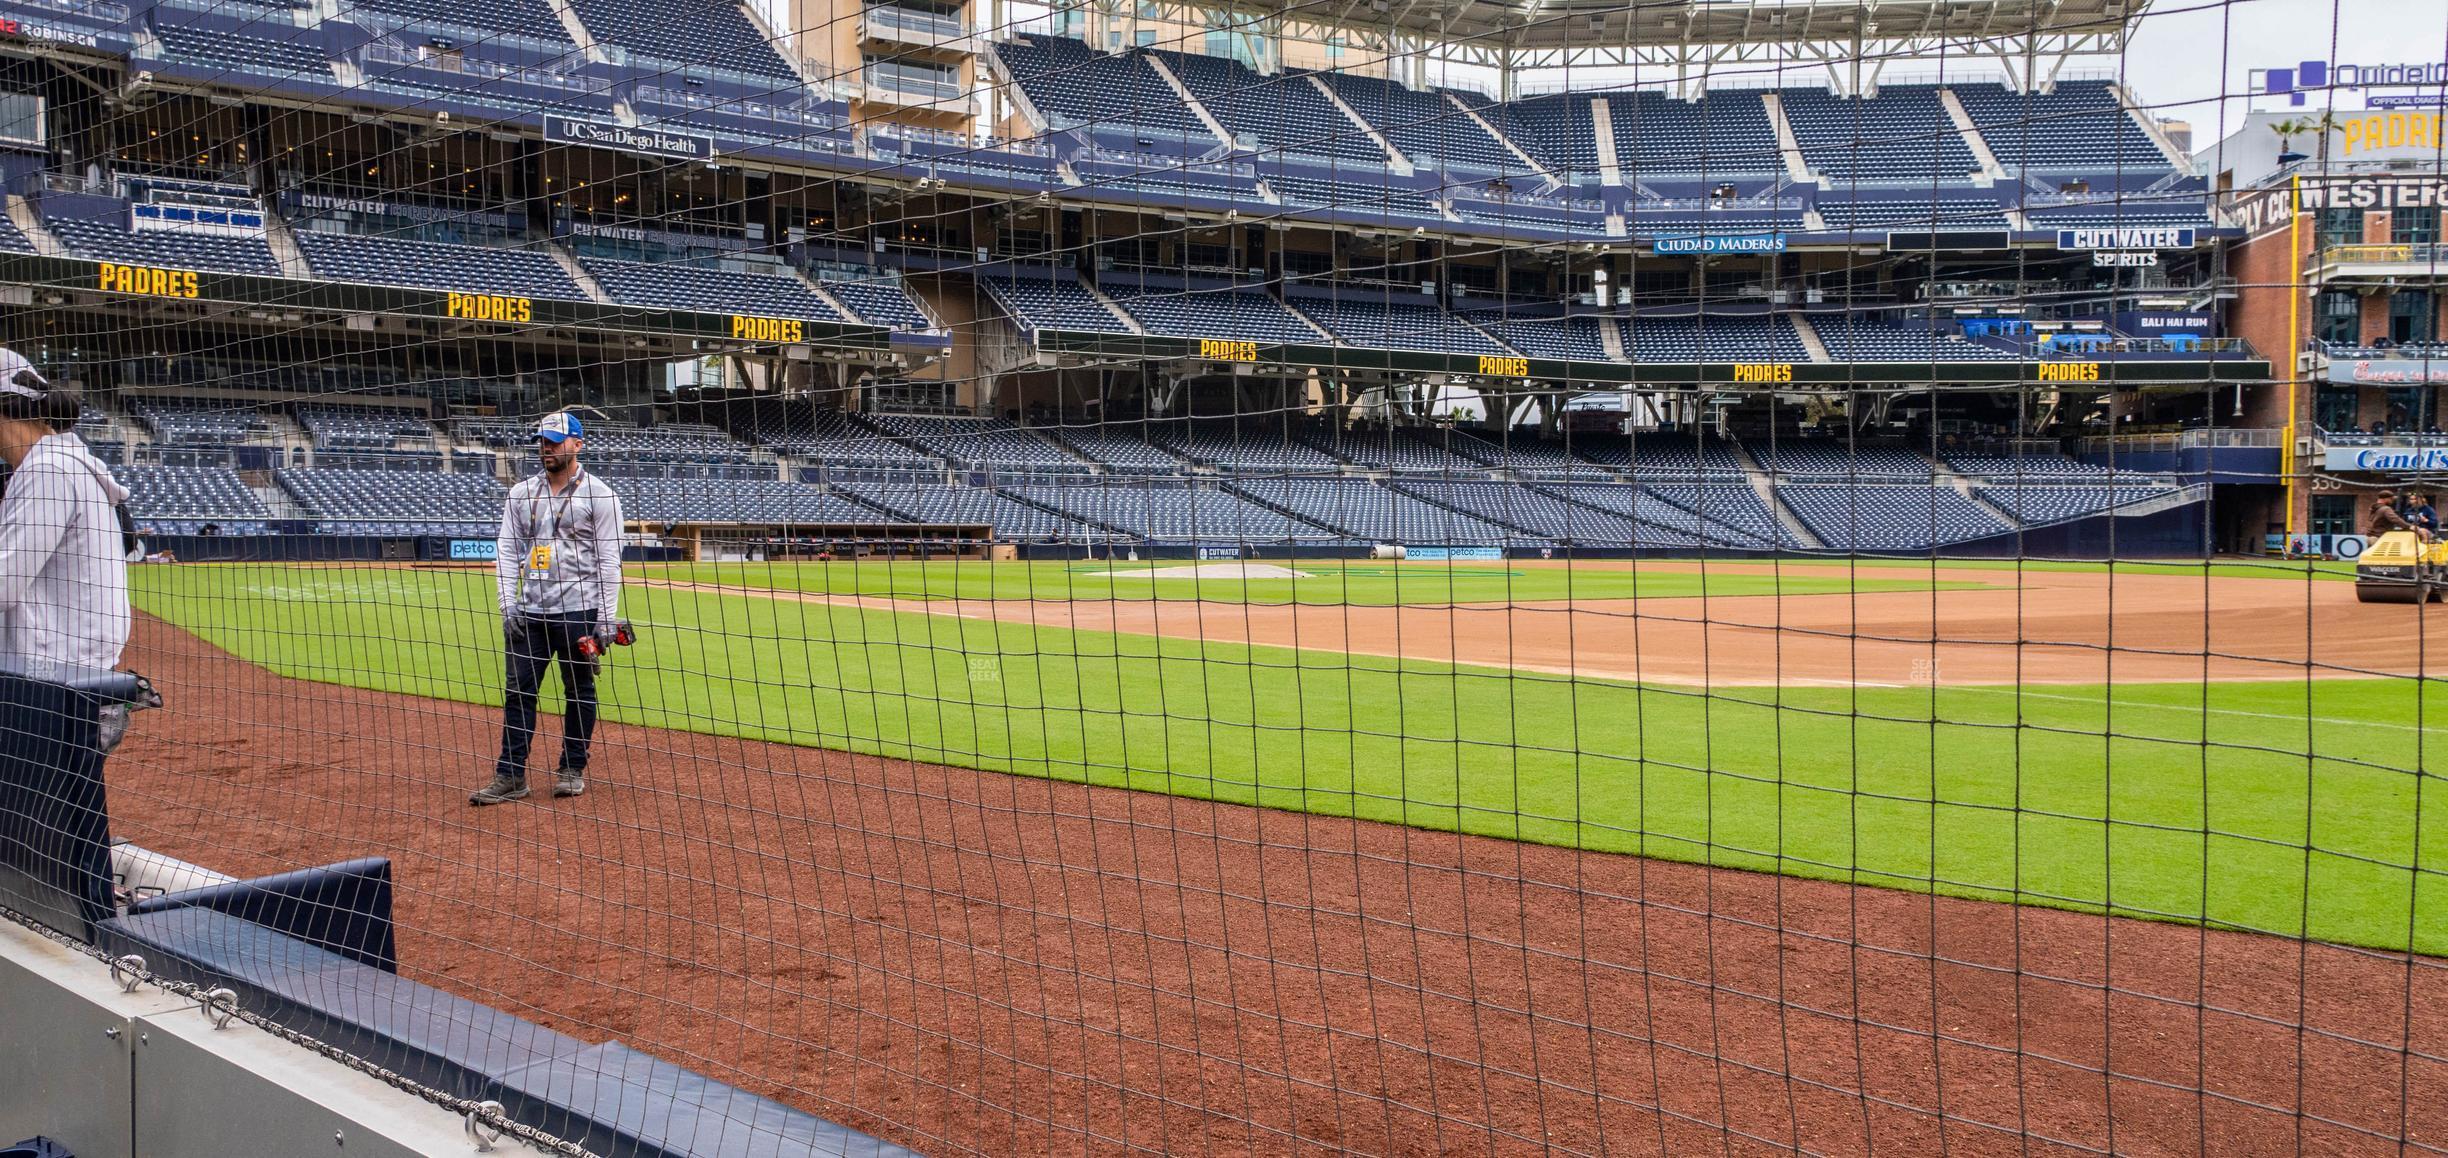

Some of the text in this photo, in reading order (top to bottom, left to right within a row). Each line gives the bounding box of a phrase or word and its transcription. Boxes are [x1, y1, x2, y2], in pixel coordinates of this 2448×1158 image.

[21, 23, 97, 47] ROBINSON
[563, 121, 697, 154] UC San Diego Health
[302, 195, 386, 215] CUTWATER
[573, 223, 644, 241] CUTWATER
[2073, 230, 2180, 248] CUTWATER
[1657, 238, 1784, 251] CIUDAD MADERAS
[2093, 252, 2158, 267] SPIRITS
[100, 262, 199, 298] PADRES
[447, 293, 531, 322] PADRES
[733, 316, 802, 343] PADRES
[2141, 318, 2208, 327] BALI HAI RUM
[1200, 339, 1257, 362] PADRES
[1479, 355, 1528, 376] PADRES
[1734, 364, 1792, 381] PADRES
[2038, 361, 2099, 381] PADRES
[453, 542, 495, 556] petco
[1208, 548, 1239, 556] CUTWATER
